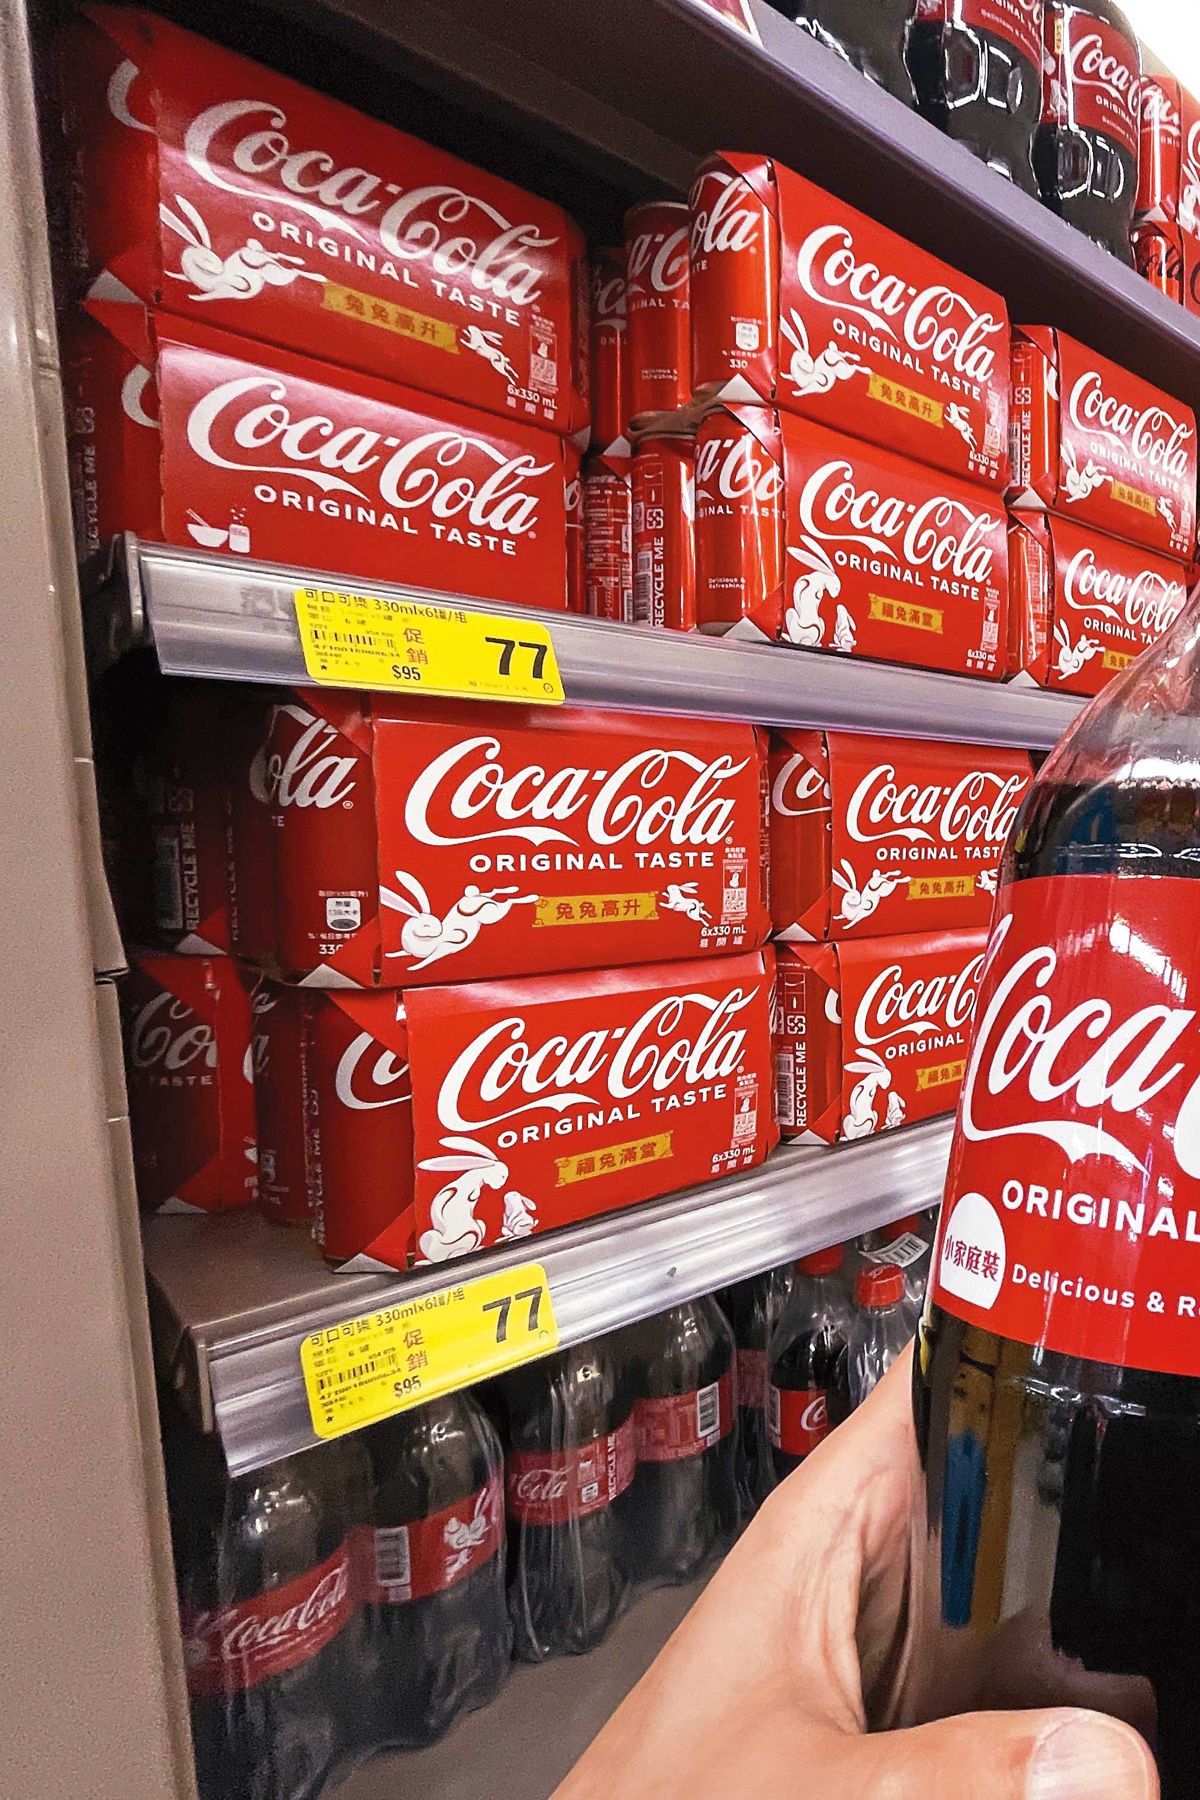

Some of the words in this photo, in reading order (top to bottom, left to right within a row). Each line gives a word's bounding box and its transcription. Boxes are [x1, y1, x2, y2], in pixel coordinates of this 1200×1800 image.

[184, 100, 560, 305] Coca-Cola
[252, 210, 418, 288] ORIGINAL
[431, 279, 520, 327] TASTE
[798, 225, 1005, 383] Coca-Cola
[832, 317, 923, 375] ORIGINAL
[930, 358, 981, 402] TASTE
[1022, 411, 1031, 429] ME
[1069, 372, 1194, 479] Coca-Cola
[187, 376, 555, 536] Coca-Cola
[1022, 431, 1031, 487] RECYCLE
[1090, 443, 1144, 477] ORIGINAL
[1149, 469, 1179, 493] TASTE
[254, 484, 418, 535] ORIGINAL
[430, 522, 517, 556] TASTE
[741, 505, 785, 519] TAST
[799, 460, 1001, 583] Coca-Cola
[654, 537, 664, 557] ME
[654, 559, 664, 627] RECYCLE
[834, 550, 925, 588] ORIGINAL
[930, 574, 981, 601] TASTE
[1064, 549, 1186, 633] Coca-Cola
[1084, 616, 1137, 642] ORIGINAL
[392, 665, 421, 681] $95
[484, 637, 547, 679] 77
[405, 736, 750, 847] Coca-Cola
[846, 764, 1029, 843] Coca-Cola
[469, 852, 623, 874] ORIGINAL
[635, 851, 715, 869] TASTE
[876, 847, 958, 862] ORIGINAL
[965, 845, 1002, 859] TAST
[556, 898, 643, 921] 兔兔高升
[701, 926, 730, 936] 6x330
[733, 925, 746, 934] mL
[854, 965, 985, 1046] Coca-C
[438, 985, 760, 1133] Coca-Cola
[795, 1041, 806, 1063] ME
[885, 1034, 965, 1060] ORIGINAL
[796, 1066, 807, 1127] RECYCLE
[928, 1065, 963, 1085] 福兔滿
[497, 1104, 641, 1150] ORIGINAL
[651, 1083, 727, 1114] TASTE
[576, 1141, 657, 1175] 福兔滿堂
[712, 1148, 740, 1163] 6x330
[743, 1145, 756, 1155] mL
[945, 1235, 1000, 1281] 小家庭裝
[1012, 1262, 1135, 1309] Delicious
[1146, 1291, 1166, 1312] &
[482, 1286, 543, 1343] 77
[393, 1375, 422, 1398] $95
